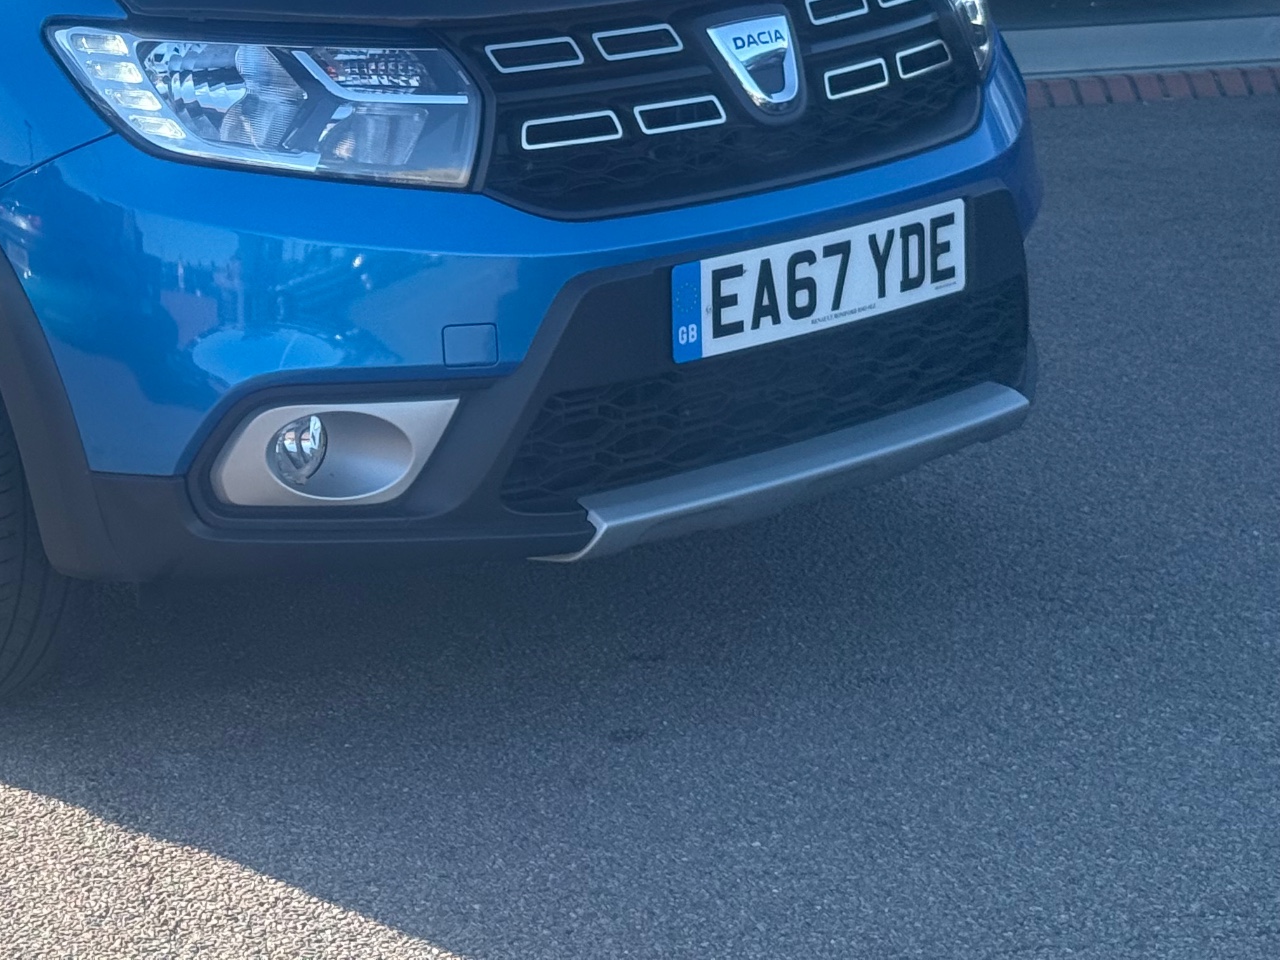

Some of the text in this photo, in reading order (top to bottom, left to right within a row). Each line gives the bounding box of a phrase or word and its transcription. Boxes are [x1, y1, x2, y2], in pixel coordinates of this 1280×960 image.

[732, 29, 786, 50] DACIA
[711, 212, 956, 339] EA67 YDE
[677, 323, 698, 345] GB
